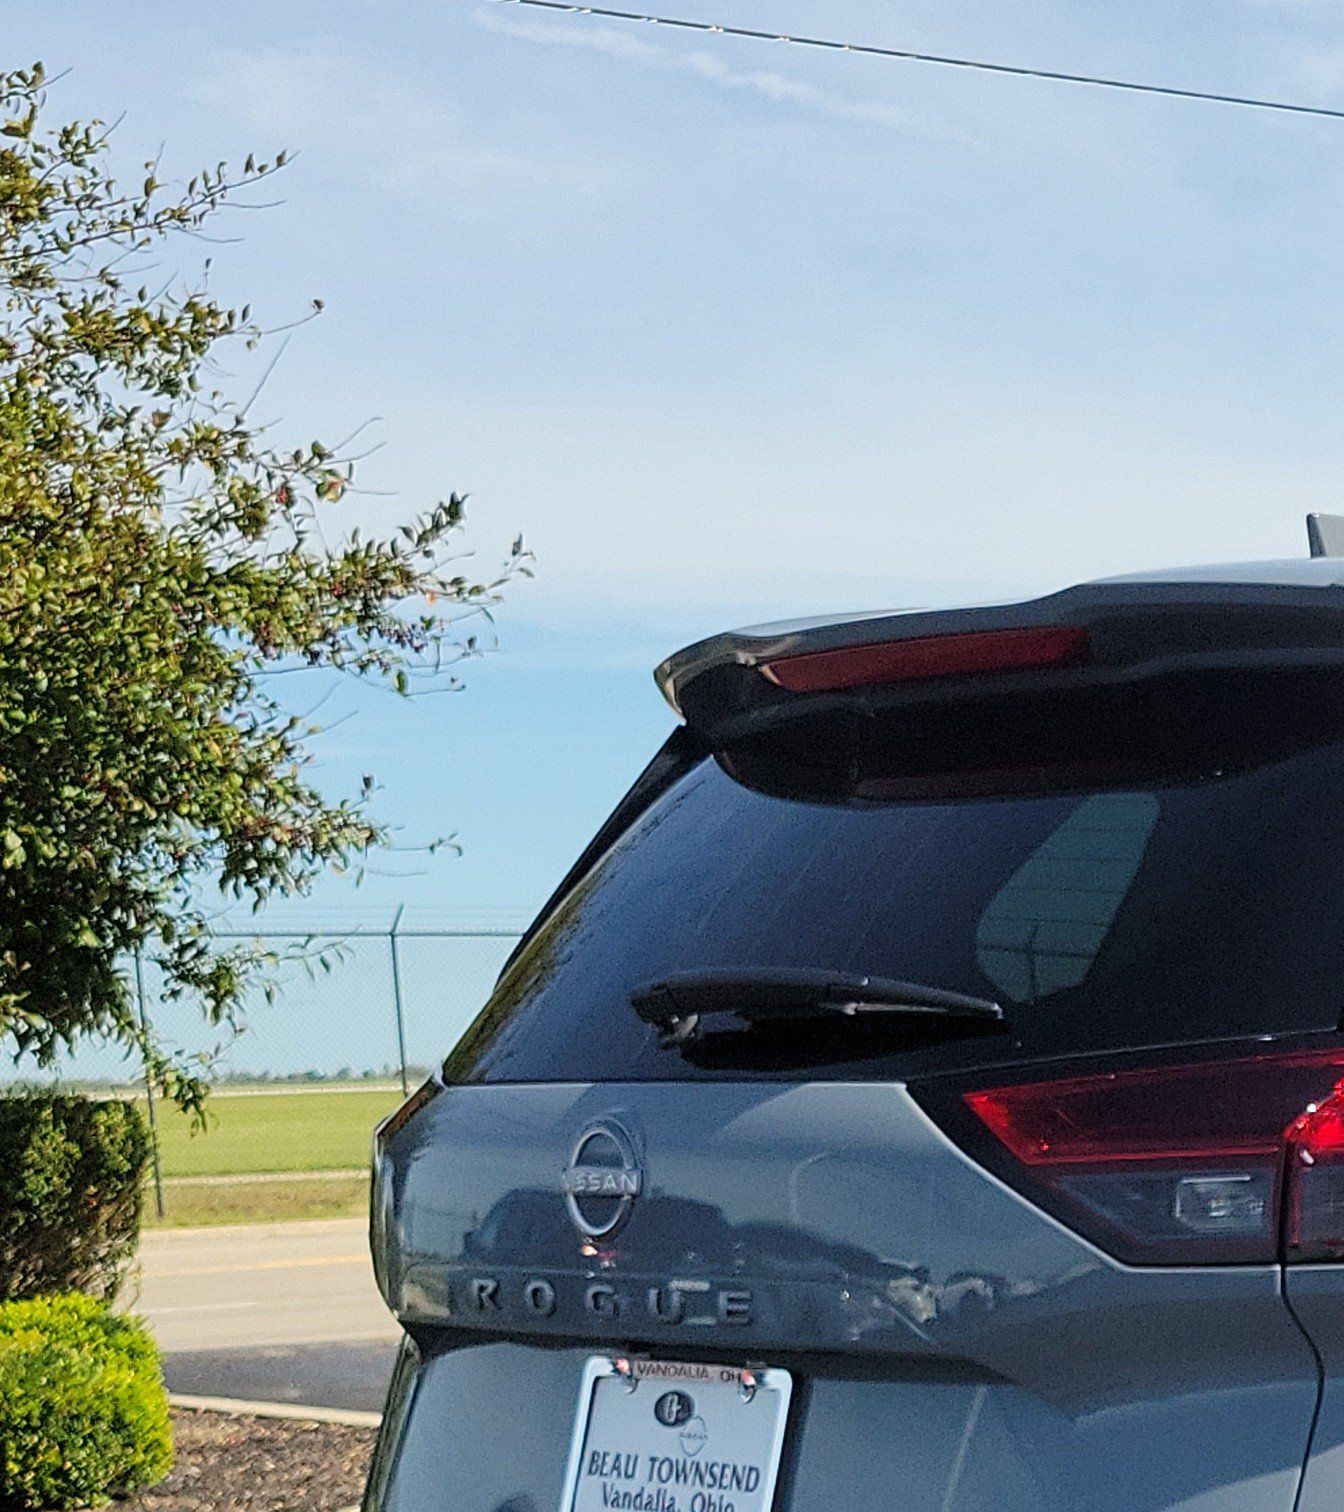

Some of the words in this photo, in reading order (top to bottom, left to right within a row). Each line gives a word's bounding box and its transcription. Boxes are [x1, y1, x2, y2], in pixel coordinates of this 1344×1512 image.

[562, 1170, 638, 1193] SSAN
[470, 1278, 752, 1324] ROGUE
[587, 1450, 639, 1480] BEAU
[649, 1456, 761, 1493] TOWNSEND
